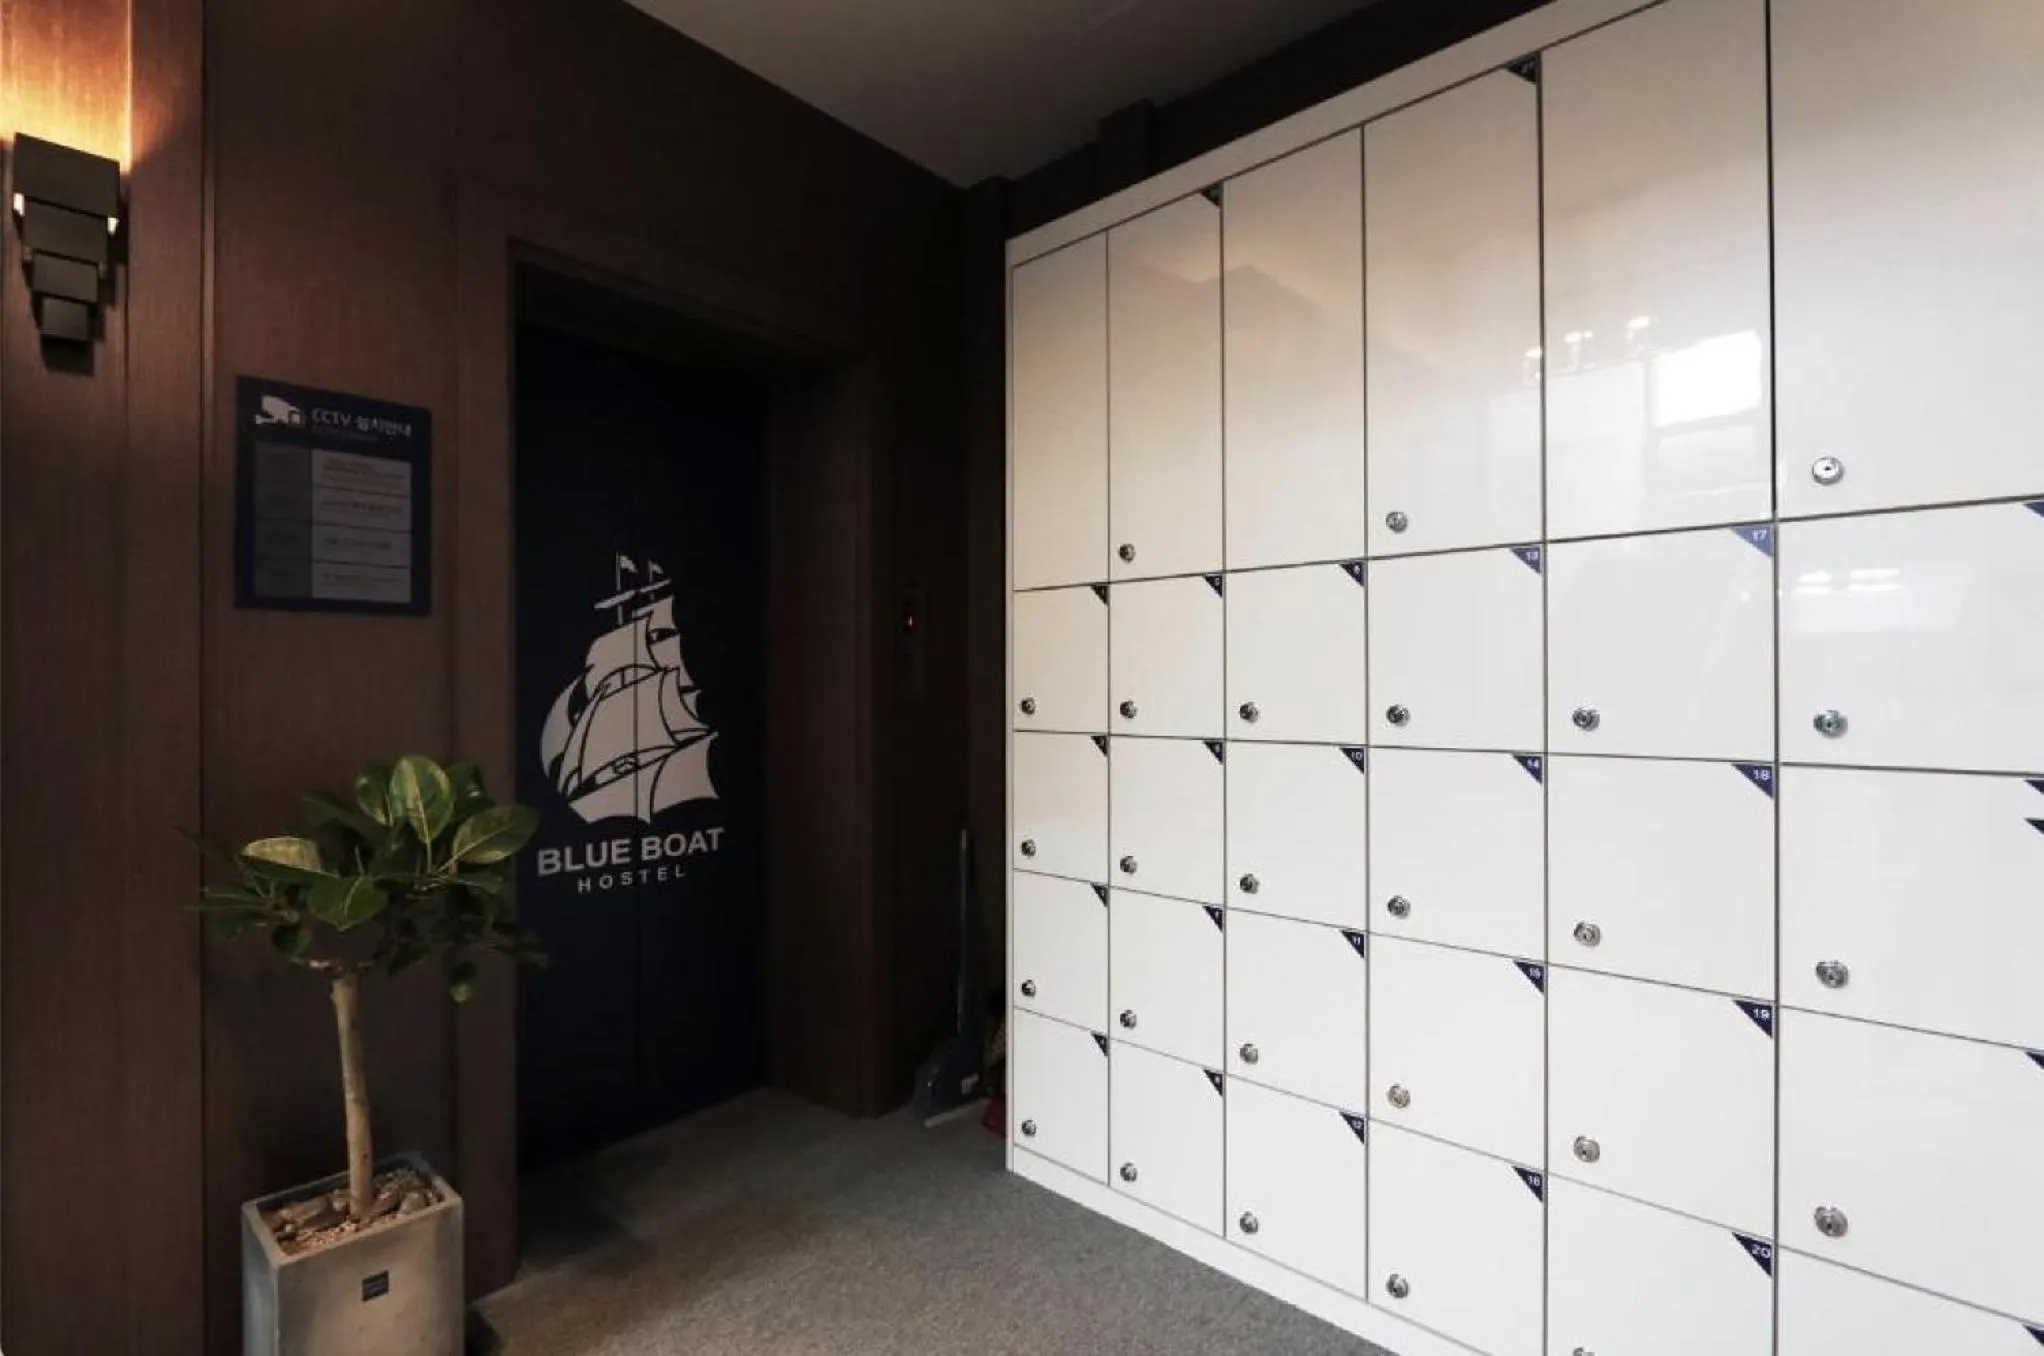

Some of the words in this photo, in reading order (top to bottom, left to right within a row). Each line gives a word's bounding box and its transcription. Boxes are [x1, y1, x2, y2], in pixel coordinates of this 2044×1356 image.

[311, 407, 351, 427] CCTV
[1752, 529, 1767, 541] 17
[1753, 769, 1770, 781] 18
[537, 838, 632, 876] BLUE
[641, 826, 725, 861] BOAT
[577, 864, 686, 894] HOSTEL
[1753, 1008, 1770, 1021] 19
[1751, 1243, 1770, 1259] 20
